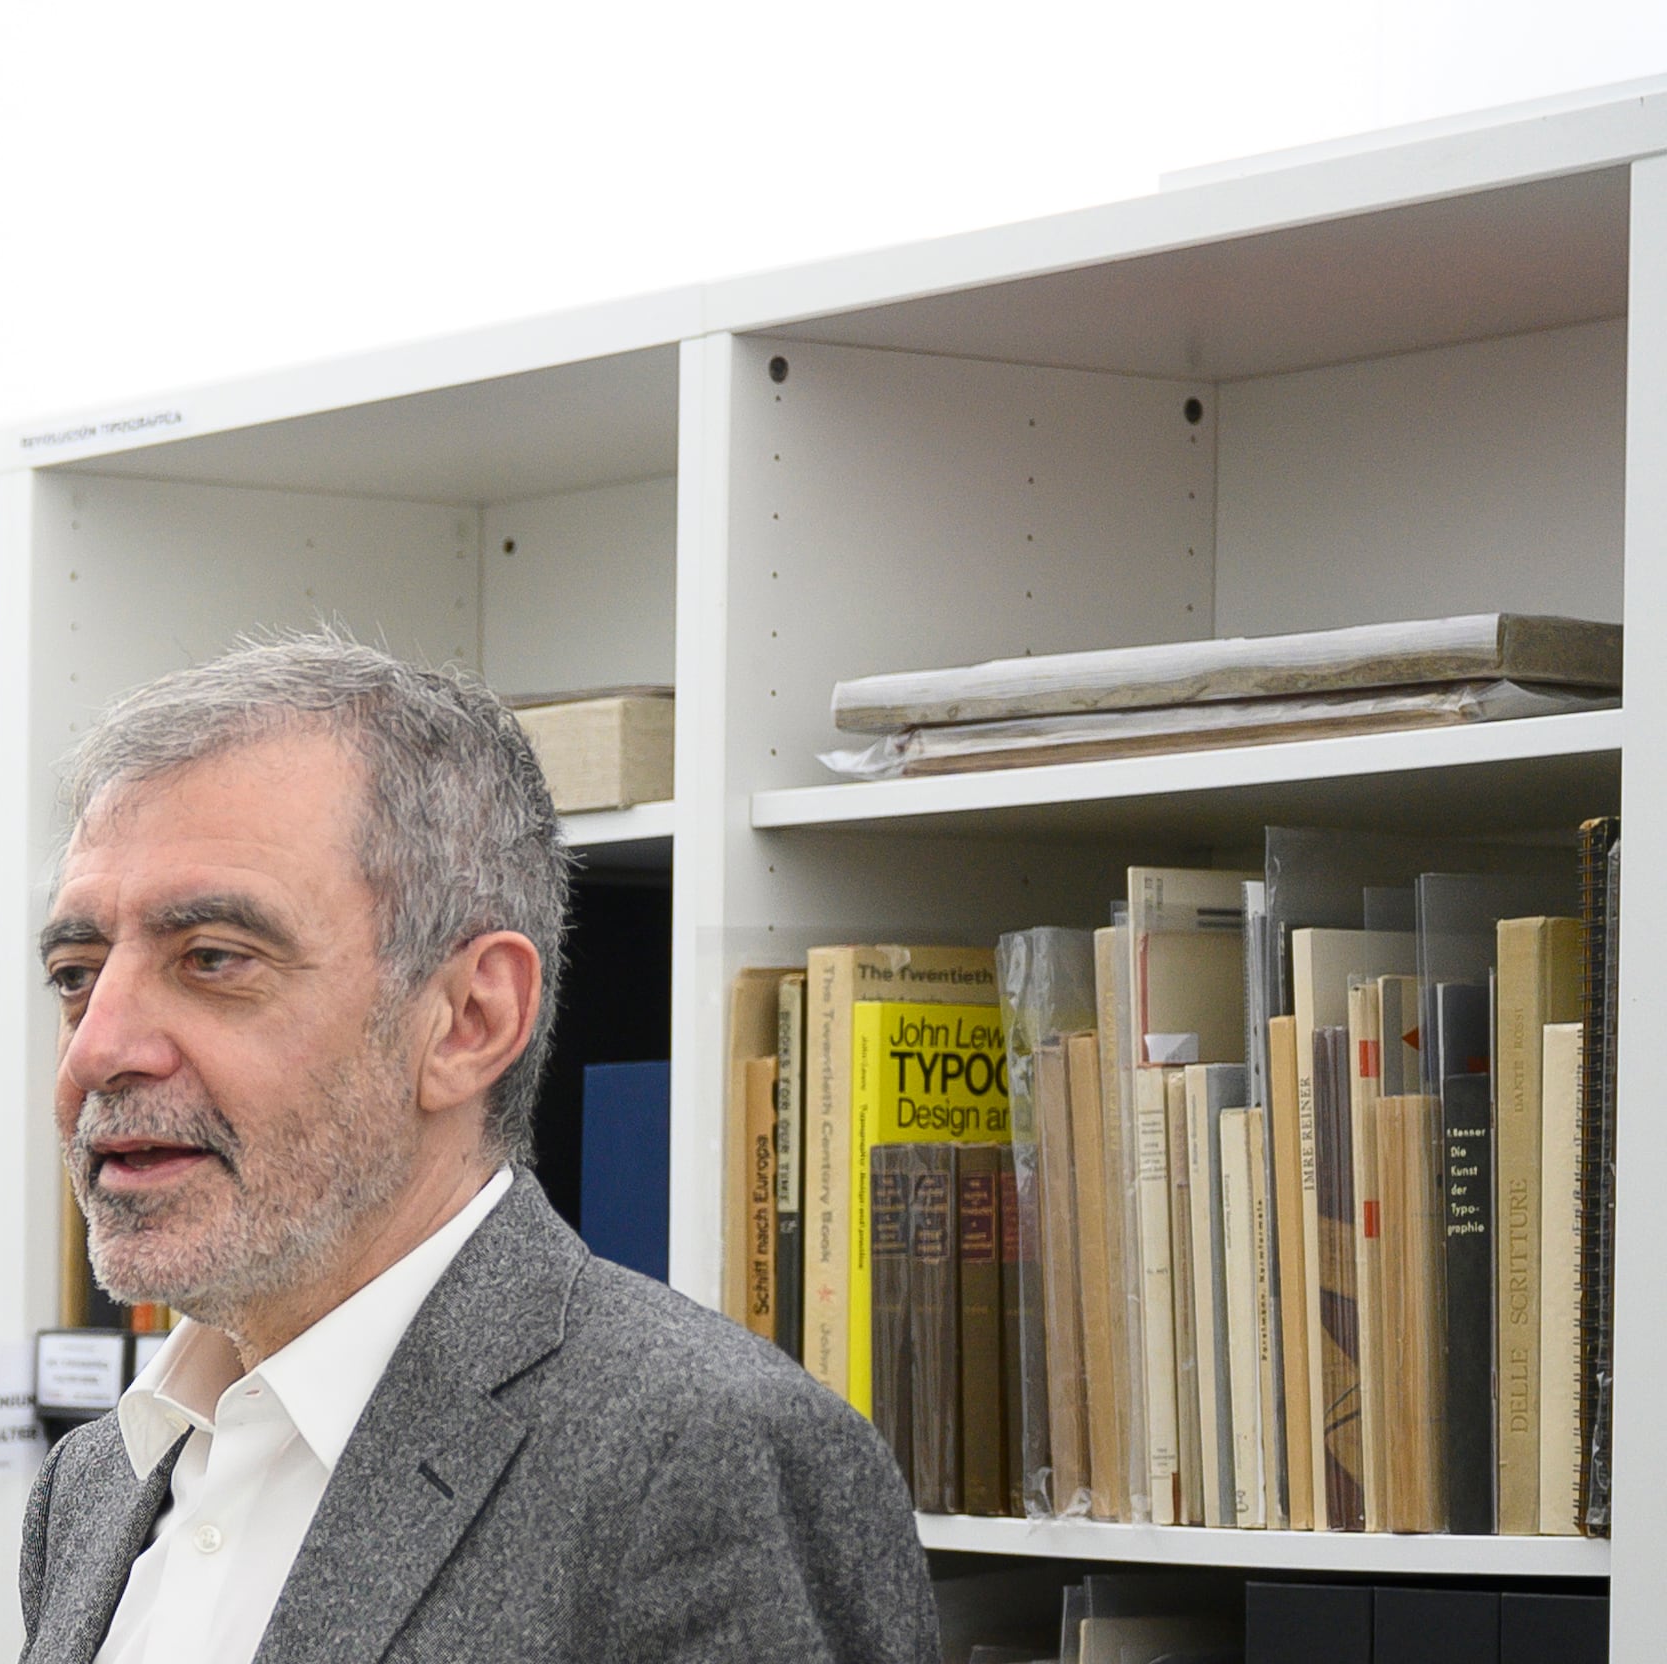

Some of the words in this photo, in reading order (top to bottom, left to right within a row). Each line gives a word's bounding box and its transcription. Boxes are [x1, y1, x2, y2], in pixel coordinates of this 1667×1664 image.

[822, 963, 837, 1005] The
[858, 963, 893, 982] The
[900, 965, 994, 985] Twentieth
[890, 1015, 950, 1048] John
[821, 1008, 836, 1116] Twentieth
[898, 1097, 980, 1137] Design
[1300, 1075, 1313, 1147] REINER
[755, 1134, 771, 1204] Europa
[818, 1120, 835, 1206] Century
[1302, 1149, 1315, 1193] IMRE
[1450, 1145, 1467, 1158] Die
[1450, 1165, 1478, 1177] Kunst
[1450, 1183, 1467, 1196] der
[1450, 1202, 1480, 1217] Typo-
[755, 1206, 770, 1256] nach
[820, 1210, 833, 1265] Book
[1447, 1220, 1485, 1237] graphie
[1510, 1178, 1528, 1328] SCRITTURE
[752, 1259, 770, 1318] Schiff
[1510, 1348, 1529, 1435] DELLE
